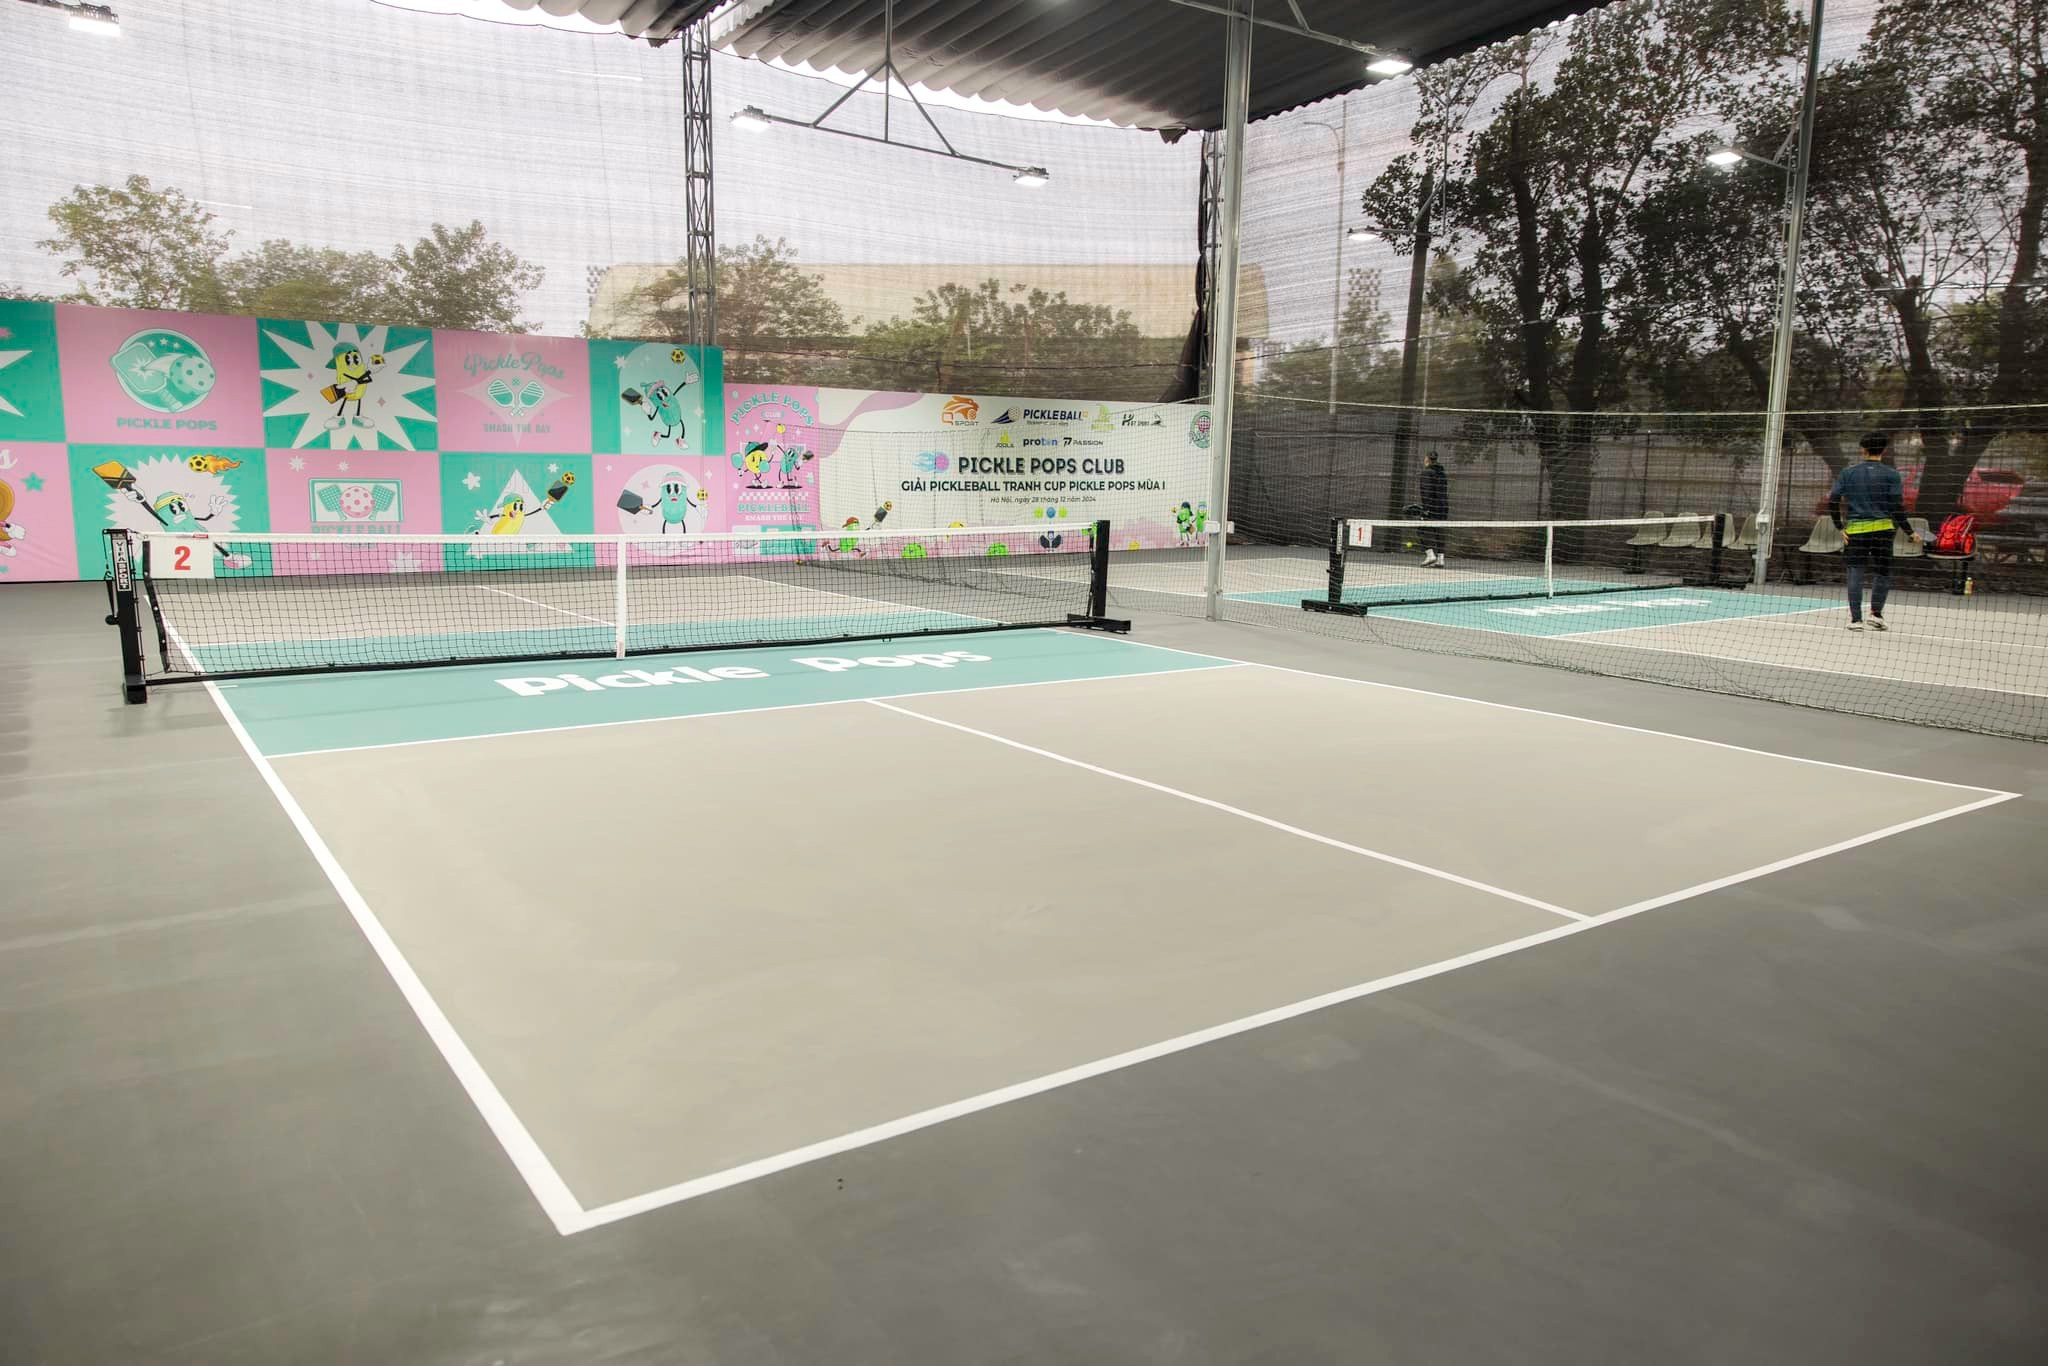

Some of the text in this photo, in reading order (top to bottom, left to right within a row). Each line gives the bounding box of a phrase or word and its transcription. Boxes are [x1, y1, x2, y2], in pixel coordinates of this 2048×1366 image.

[731, 392, 815, 427] PICKLE POPS
[1023, 408, 1084, 421] PICKLEBALL
[116, 417, 219, 432] PICKLE POPS
[958, 456, 1125, 474] PICKLE POPS CLUB
[901, 476, 926, 492] GIẢI
[930, 480, 1001, 492] PICKLEBALL
[1003, 480, 1041, 492] TRANH
[1044, 480, 1067, 491] CUP
[1069, 480, 1106, 491] PICKLE
[1108, 480, 1136, 491] POPS
[1138, 478, 1160, 491] MÙA
[174, 545, 192, 571] 2
[118, 563, 129, 589] SPORT
[494, 650, 993, 697] Pickle Pops
